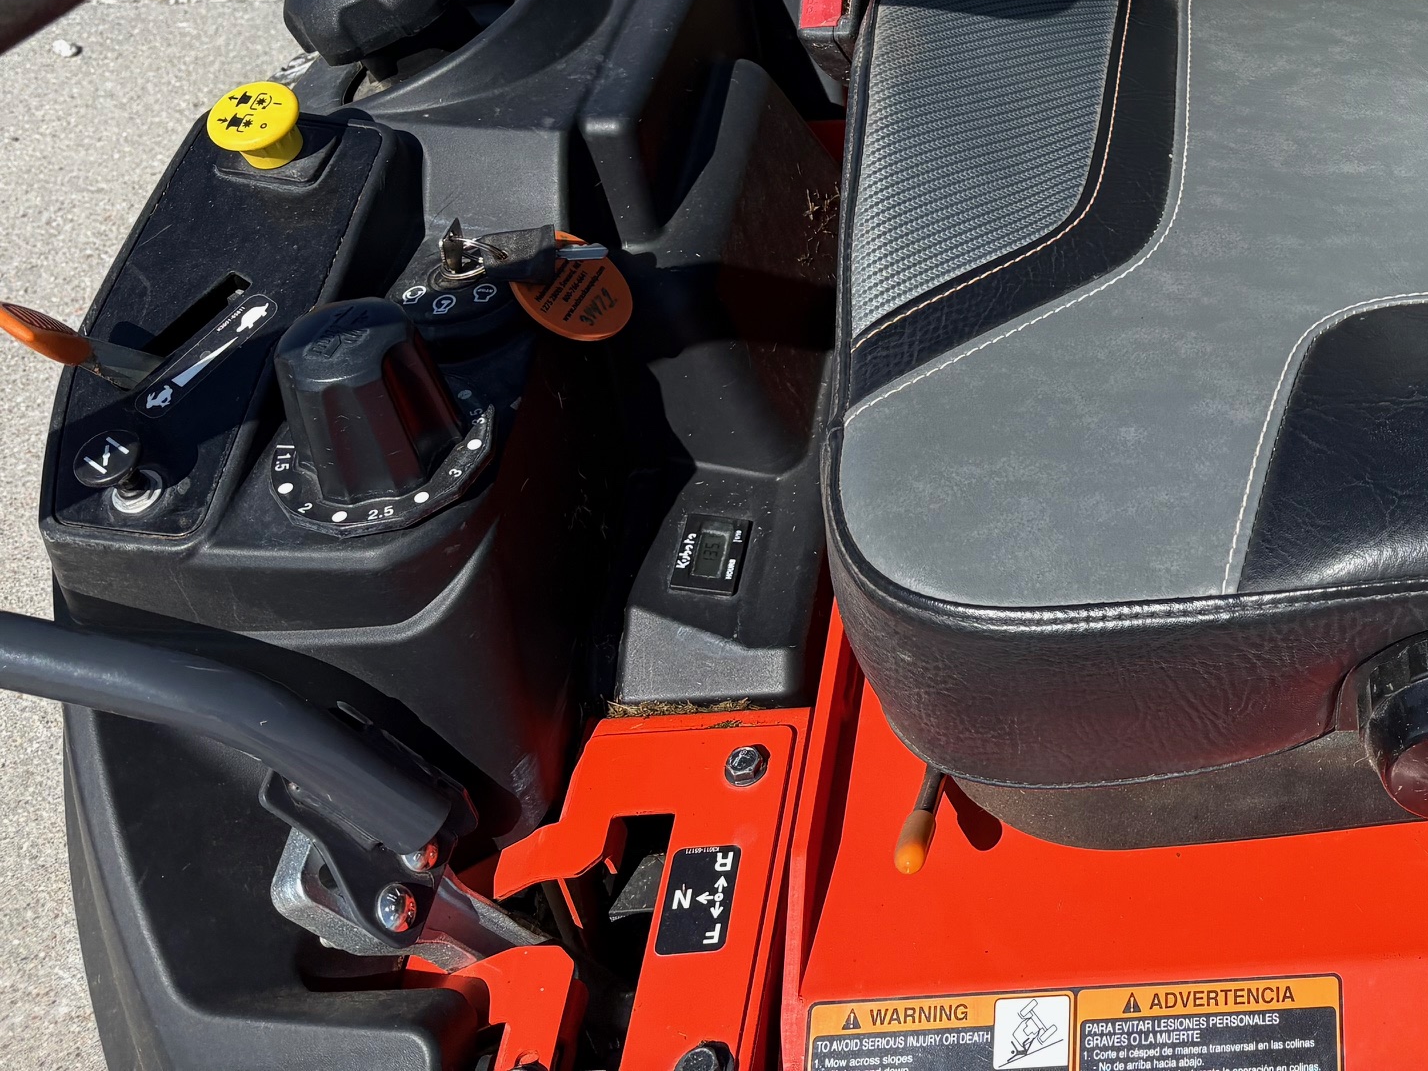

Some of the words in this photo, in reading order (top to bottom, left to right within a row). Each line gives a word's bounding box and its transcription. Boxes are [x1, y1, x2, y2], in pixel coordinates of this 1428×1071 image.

[275, 452, 290, 472] 1.5
[449, 467, 462, 478] 3
[298, 501, 313, 514] 2
[368, 506, 394, 520] 2.5
[675, 533, 697, 569] Kubota
[715, 851, 734, 871] R
[672, 888, 693, 910] N
[703, 923, 721, 944] F
[1149, 986, 1295, 1010] ADVERTENCIA
[870, 1003, 968, 1026] WARNING
[1085, 1023, 1113, 1034] PARA
[1115, 1020, 1152, 1033] EVITAR
[1154, 1017, 1207, 1031] LESIONES
[1209, 1013, 1280, 1028] PERSONALES
[816, 1041, 830, 1053] TO
[831, 1039, 860, 1052] AVOID
[863, 1035, 904, 1050] SERIOUS
[907, 1034, 942, 1048] INJURY
[943, 1033, 957, 1046] OR
[960, 1031, 991, 1044] DEATH
[1083, 1051, 1091, 1060] 1.
[1093, 1049, 1117, 1060] Corte
[1119, 1048, 1127, 1058] el
[1129, 1046, 1160, 1059] césped
[1162, 1046, 1173, 1056] de
[1175, 1045, 1208, 1055] manera
[1209, 1041, 1256, 1053] transversal
[1258, 1041, 1269, 1050] en
[1271, 1040, 1284, 1049] las
[1285, 1038, 1315, 1049] colinas
[1085, 1034, 1128, 1048] GRAVES
[1130, 1034, 1139, 1045] O
[1141, 1033, 1154, 1045] LA
[1156, 1030, 1201, 1044] MUERTE
[814, 1060, 822, 1069] 1.
[825, 1058, 847, 1068] Mow
[849, 1056, 880, 1067] across
[882, 1054, 913, 1065] slopes
[1098, 1061, 1112, 1071] No
[1113, 1061, 1124, 1070] de
[1126, 1059, 1152, 1070] arriba
[1153, 1058, 1177, 1068] hacia
[1178, 1056, 1205, 1068] abajo.
